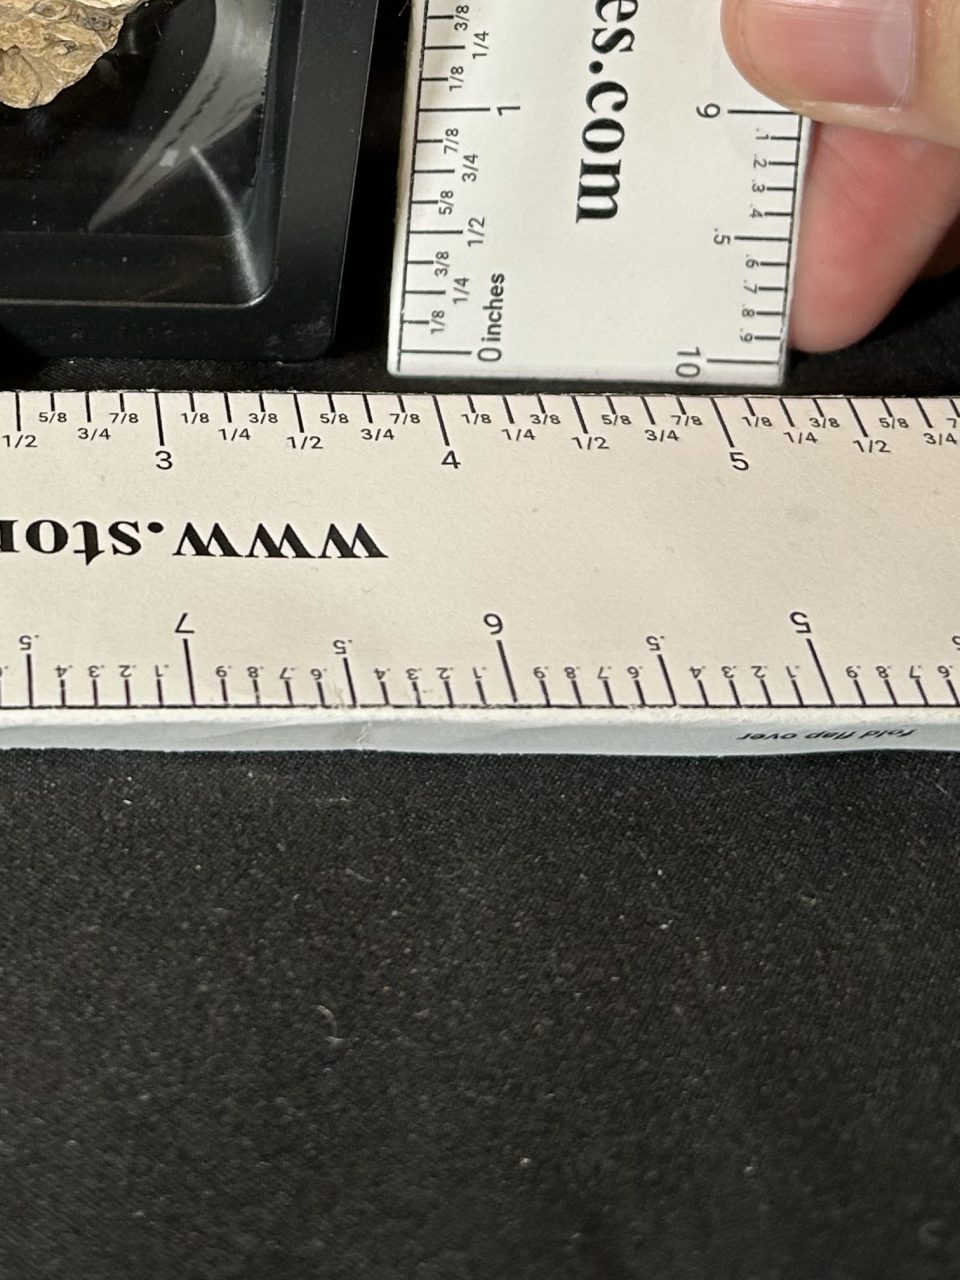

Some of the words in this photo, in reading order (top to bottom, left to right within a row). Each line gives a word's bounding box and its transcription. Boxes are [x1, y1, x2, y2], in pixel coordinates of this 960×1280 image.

[454, 5, 469, 31] 3/8
[472, 31, 489, 59] 1/4
[449, 66, 464, 91] 1/8
[497, 106, 520, 116] 1
[696, 103, 720, 118] 9
[444, 128, 459, 154] 7/8
[462, 154, 478, 182] 3/4
[439, 191, 453, 215] 5/8
[467, 217, 485, 247] 1/2
[434, 251, 450, 276] 3/8
[453, 277, 469, 304] 1/4
[481, 274, 505, 341] inches
[431, 310, 445, 334] 1/8
[477, 348, 502, 362] 0
[675, 347, 701, 381] 10
[39, 412, 67, 423] 5/8
[110, 413, 138, 424] 7/8
[181, 413, 209, 424] 1/8
[249, 413, 278, 424] 3/8
[320, 413, 349, 424] 5/8
[390, 413, 420, 425] 7/8
[461, 414, 491, 425] 1/8
[530, 412, 561, 425] 3/8
[601, 412, 631, 426] 5/8
[671, 415, 703, 426] 7/8
[742, 417, 772, 427] 1/8
[809, 415, 840, 428] 3/8
[879, 415, 909, 429] 5/8
[78, 428, 111, 440] 3/4
[219, 428, 251, 441] 1/4
[361, 429, 395, 441] 3/4
[501, 429, 535, 441] 1/4
[645, 430, 679, 442] 3/4
[783, 432, 818, 444] 1/4
[923, 433, 957, 445] 3/4
[2, 435, 37, 448] 1/2
[287, 436, 323, 449] 1/2
[572, 437, 609, 450] 1/2
[853, 440, 891, 453] 1/2
[155, 451, 172, 470] 3
[441, 450, 461, 469] 4
[730, 452, 749, 471] 5
[175, 613, 194, 634] 7
[484, 613, 503, 635] 6
[790, 612, 811, 633] 5
